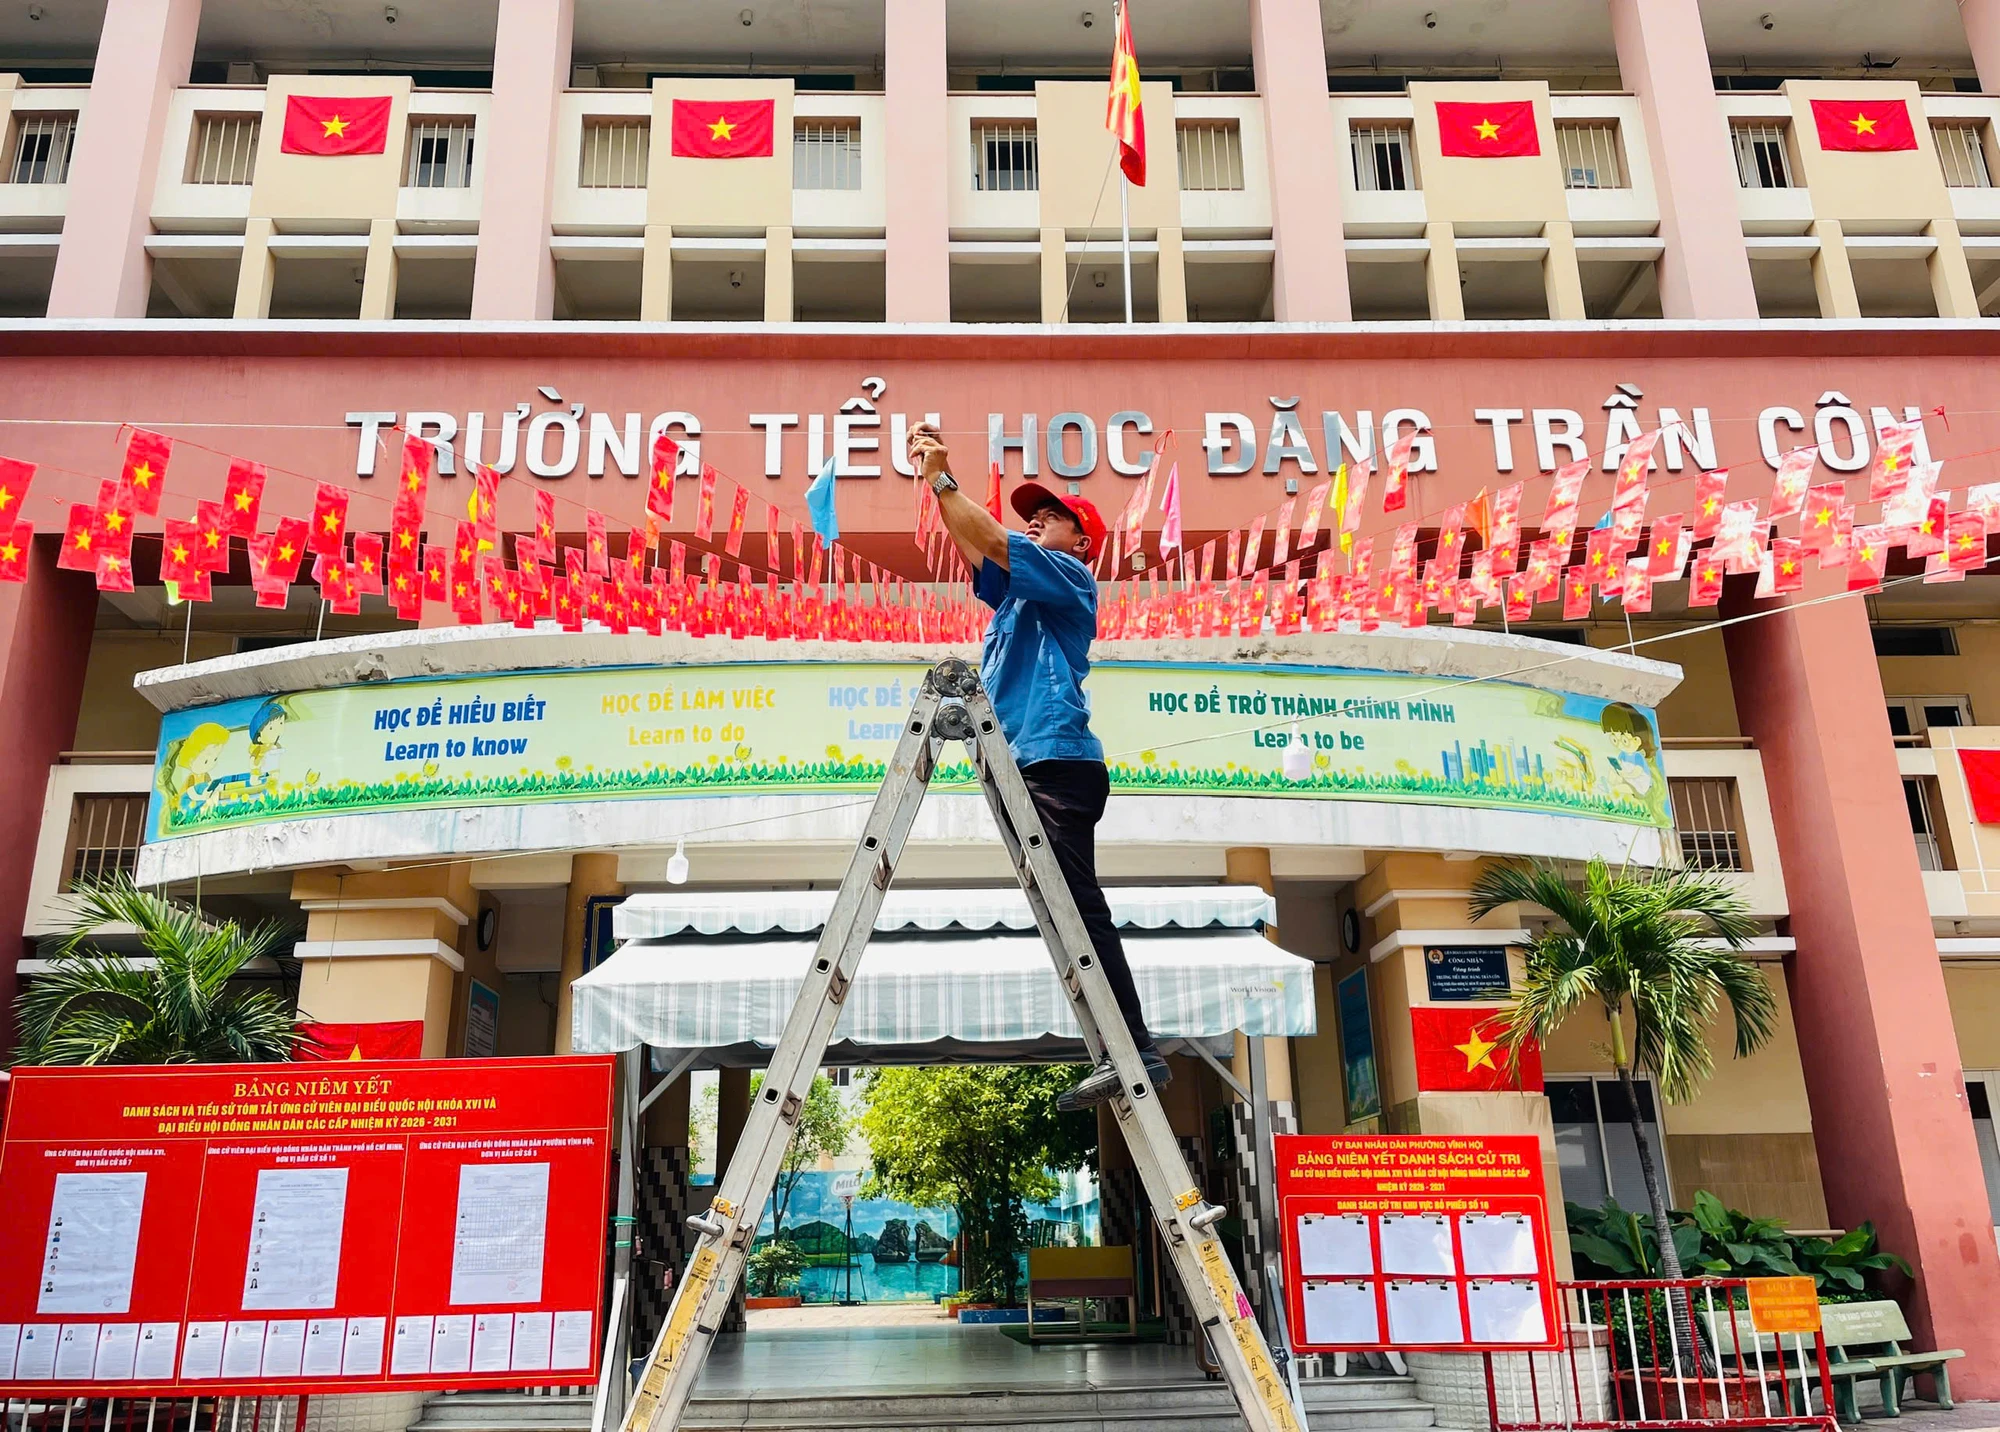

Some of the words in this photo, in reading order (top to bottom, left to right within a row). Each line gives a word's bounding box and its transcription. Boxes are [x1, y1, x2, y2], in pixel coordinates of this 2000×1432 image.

[345, 386, 701, 478] TRƯỜNG
[749, 378, 940, 478] TIỂU
[988, 410, 1153, 495] HỌC
[1202, 396, 1438, 494] ĐẶNG
[1474, 383, 1718, 472] TRẦN
[601, 693, 641, 717] HỌC
[648, 683, 674, 711] ĐỂ
[681, 687, 725, 710] LÀM
[732, 685, 775, 711] VIỆC
[829, 687, 868, 710] HỌC
[875, 678, 901, 706] ĐỂ
[1149, 692, 1188, 716] HỌC
[1195, 685, 1220, 713] ĐỂ
[1227, 689, 1266, 715] TRỞ
[1271, 693, 1337, 718] THÀNH
[1344, 696, 1401, 720] CHÍNH
[1408, 699, 1455, 722] MÌNH
[374, 708, 411, 732] HỌC
[417, 697, 442, 726] ĐỂ
[449, 695, 496, 724] HIỂU
[502, 694, 546, 721] BIẾT
[629, 726, 685, 745] Learn
[692, 724, 712, 742] to
[720, 721, 745, 742] do
[1315, 731, 1333, 749] to
[1340, 731, 1364, 750] be
[385, 742, 439, 761] Learn
[446, 739, 465, 757] to
[472, 737, 528, 756] know
[234, 1077, 289, 1097] BẢNG
[294, 1077, 348, 1095] NIÊM
[353, 1075, 392, 1094] YẾT
[123, 1106, 150, 1117] DANH
[153, 1104, 179, 1116] SÁCH
[182, 1104, 194, 1116] VÀ
[197, 1102, 219, 1115] TIỂU
[222, 1103, 236, 1115] SỬ
[238, 1103, 258, 1115] TÓM
[261, 1100, 279, 1114] TẮT
[281, 1101, 301, 1113] ỨNG
[303, 1100, 316, 1113] CỬ
[319, 1100, 341, 1112] VIÊN
[344, 1102, 361, 1114] ĐẠI
[363, 1098, 386, 1111] BIỂU
[389, 1098, 415, 1111] QUỐC
[418, 1098, 434, 1112] HỘI
[437, 1098, 462, 1110] KHÓA
[465, 1099, 481, 1109] XVI
[484, 1097, 496, 1109] VÀ
[158, 1123, 176, 1134] ĐẠI
[178, 1119, 201, 1132] BIỂU
[204, 1119, 220, 1134] HỘI
[223, 1119, 250, 1131] ĐỒNG
[253, 1118, 280, 1130] NHÂN
[283, 1118, 304, 1130] DÂN
[306, 1117, 327, 1129] CÁC
[329, 1116, 348, 1129] CẤP
[351, 1117, 383, 1130] NHIỆM
[386, 1116, 398, 1127] KỲ
[401, 1117, 424, 1127] 2026
[434, 1116, 457, 1126] 2031
[1297, 1151, 1333, 1164] BẢNG
[1337, 1152, 1368, 1164] NIÊM
[1372, 1150, 1395, 1164] YẾT
[1399, 1154, 1435, 1164] DANH
[1438, 1152, 1473, 1164] SÁCH
[1477, 1150, 1496, 1164] CỬ
[1499, 1154, 1521, 1164] TRI
[1332, 1140, 1343, 1149] ỦY
[1364, 1140, 1388, 1148] NHÂN
[1390, 1140, 1407, 1148] DÂN
[1409, 1140, 1446, 1148] PHƯỜNG
[1469, 1140, 1483, 1150] HỘI
